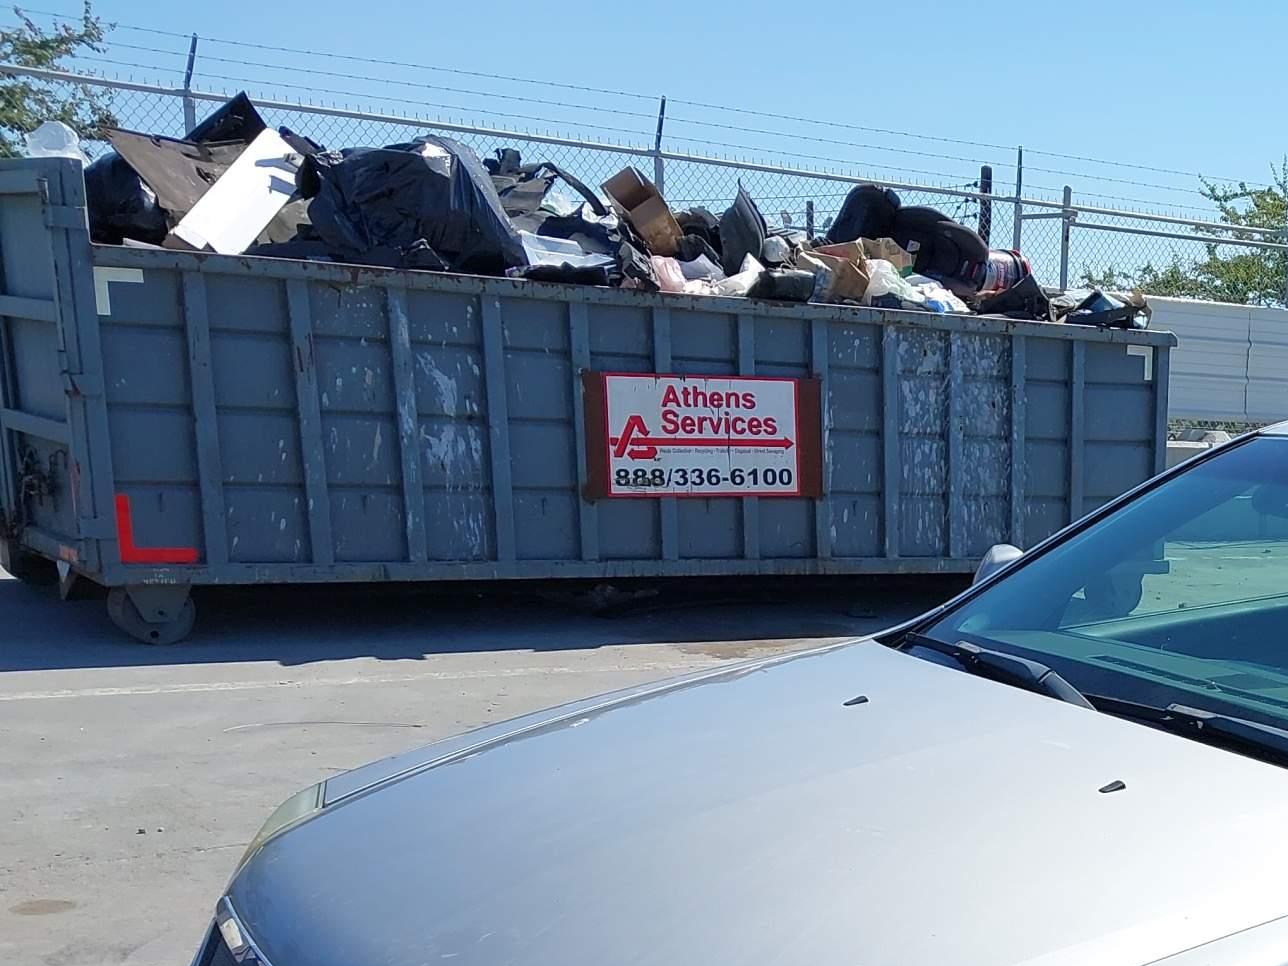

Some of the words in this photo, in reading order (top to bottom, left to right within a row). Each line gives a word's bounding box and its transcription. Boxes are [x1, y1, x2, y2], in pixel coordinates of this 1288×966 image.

[661, 385, 756, 410] Athens
[661, 409, 778, 436] Services
[614, 467, 793, 488] 888/336-6100
